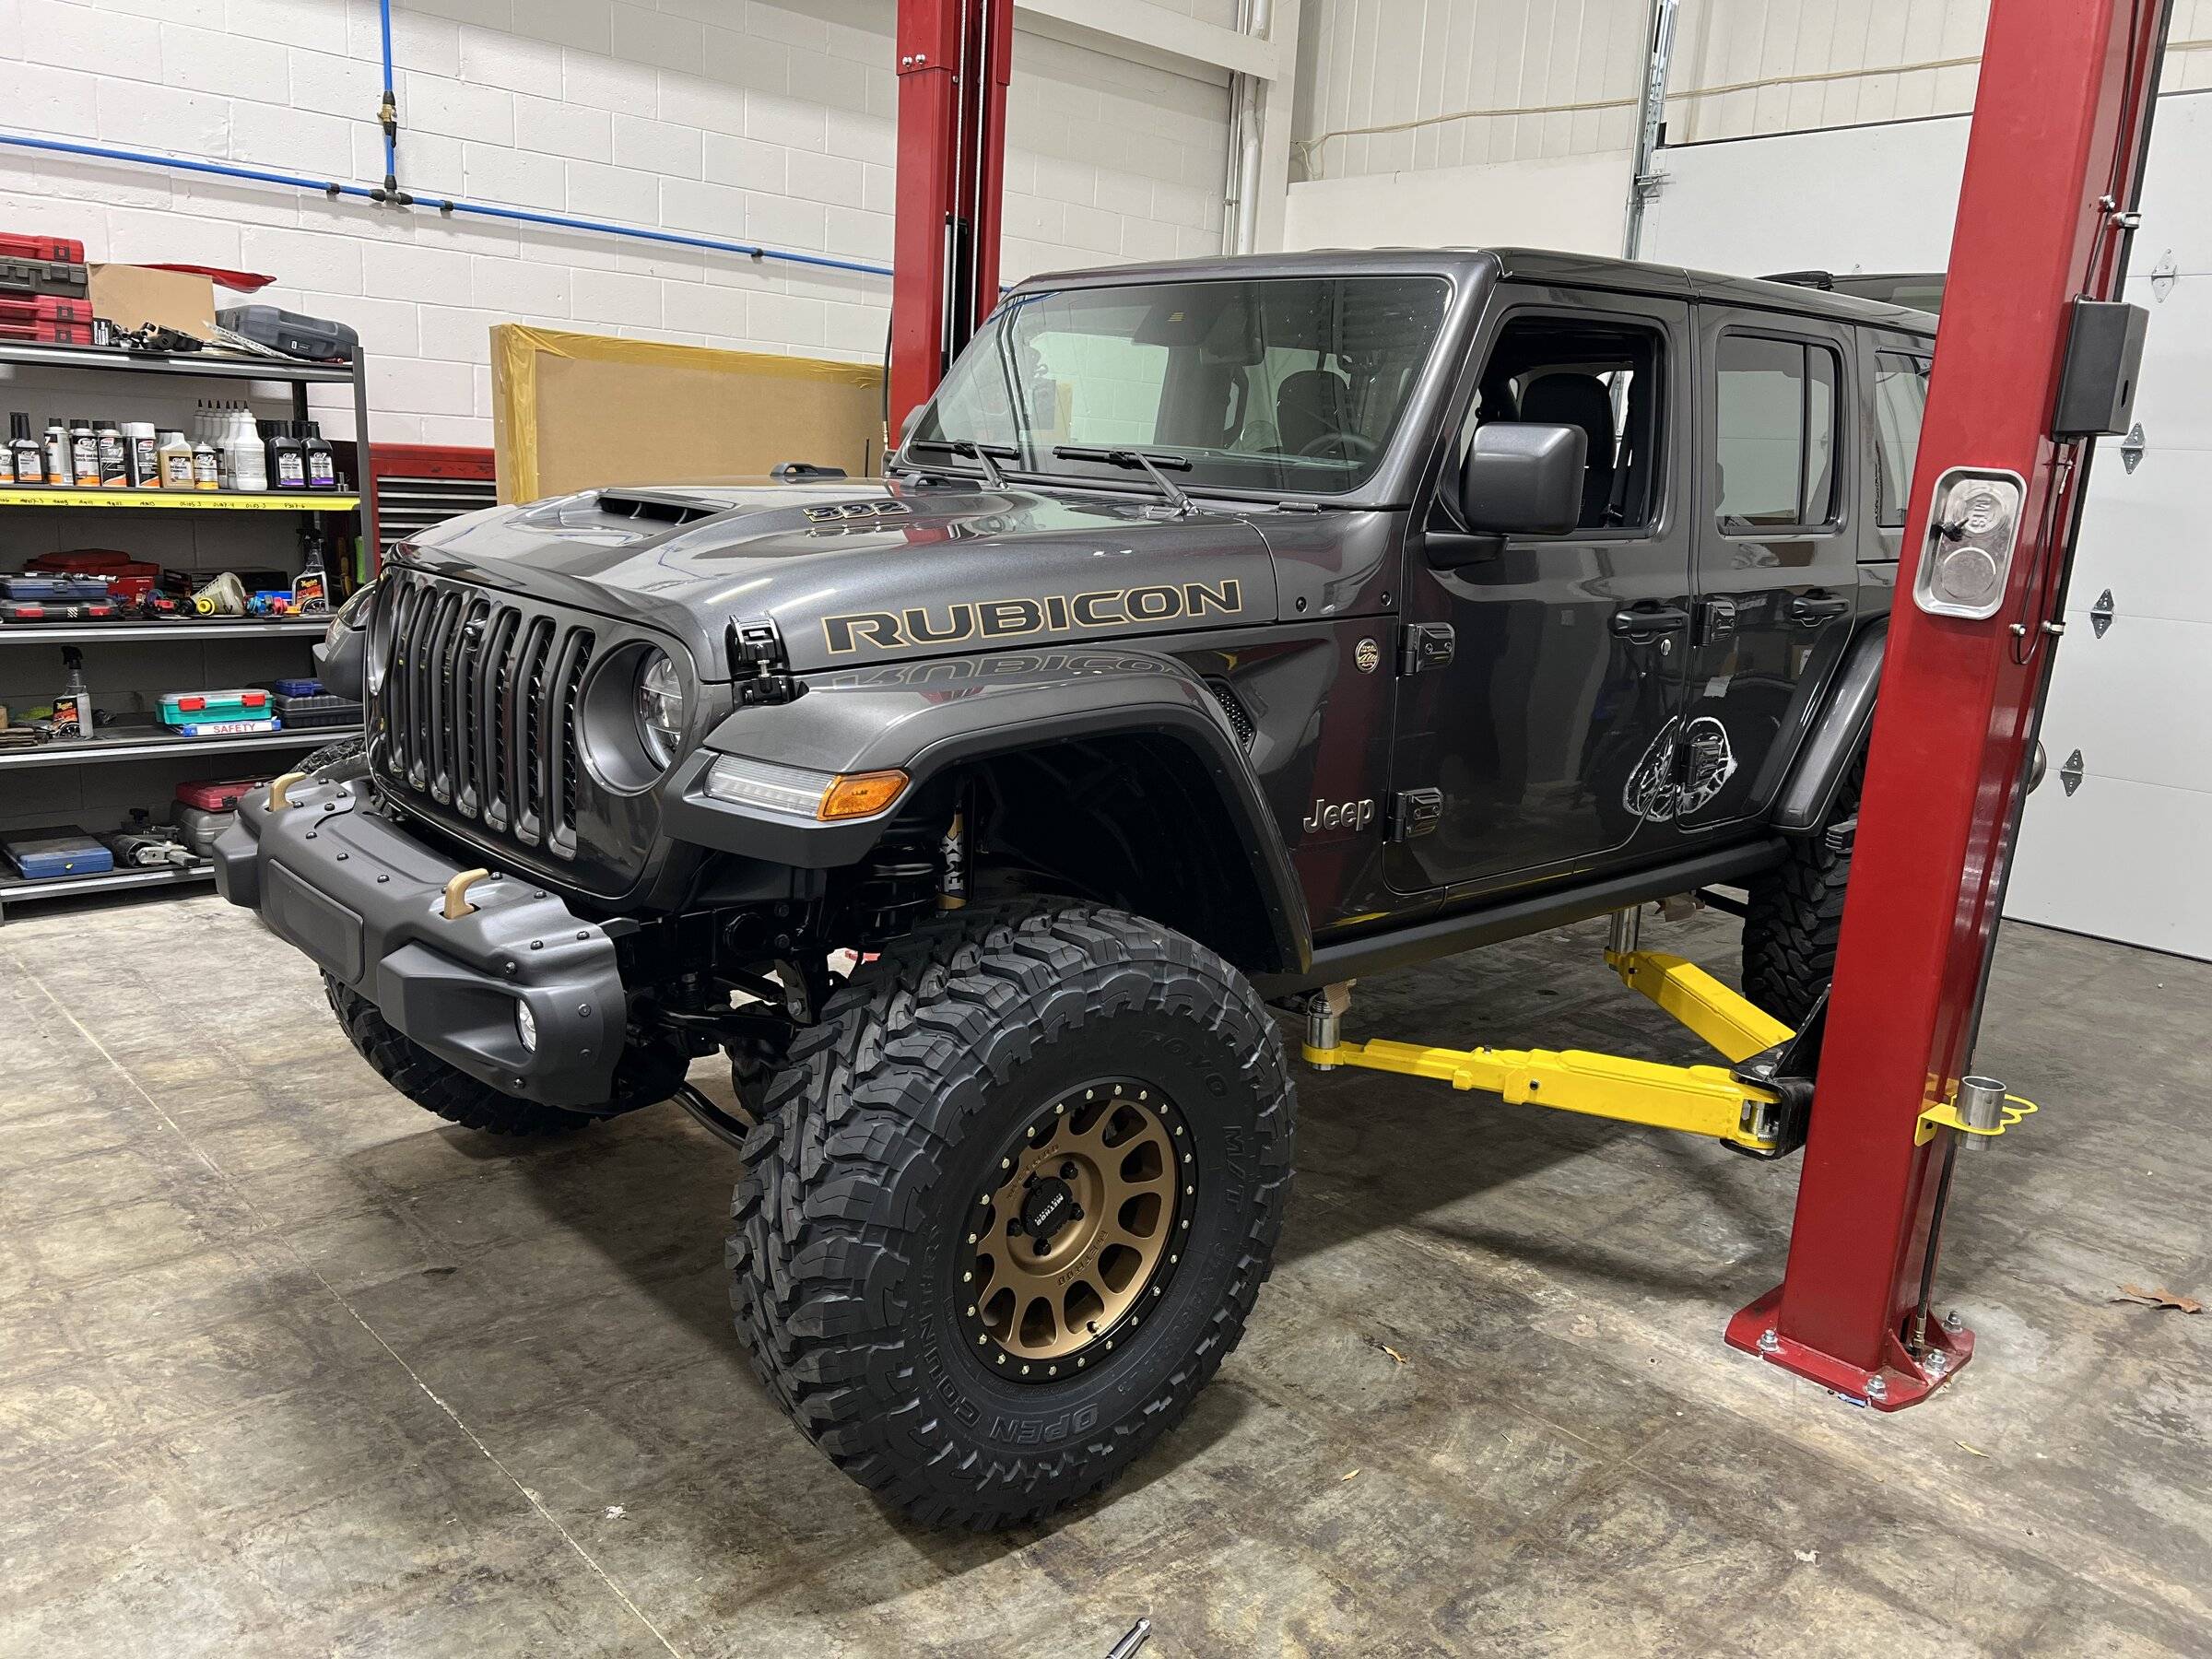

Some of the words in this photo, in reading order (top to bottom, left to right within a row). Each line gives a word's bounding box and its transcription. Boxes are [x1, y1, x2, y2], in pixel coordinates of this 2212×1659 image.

[820, 579, 1243, 654] RUBICON
[213, 723, 256, 735] SAFETY
[1303, 798, 1376, 833] Jeep
[1034, 1193, 1065, 1227] METHOD
[1056, 1230, 1110, 1288] METHOD
[989, 1402, 1100, 1445] OPEN
